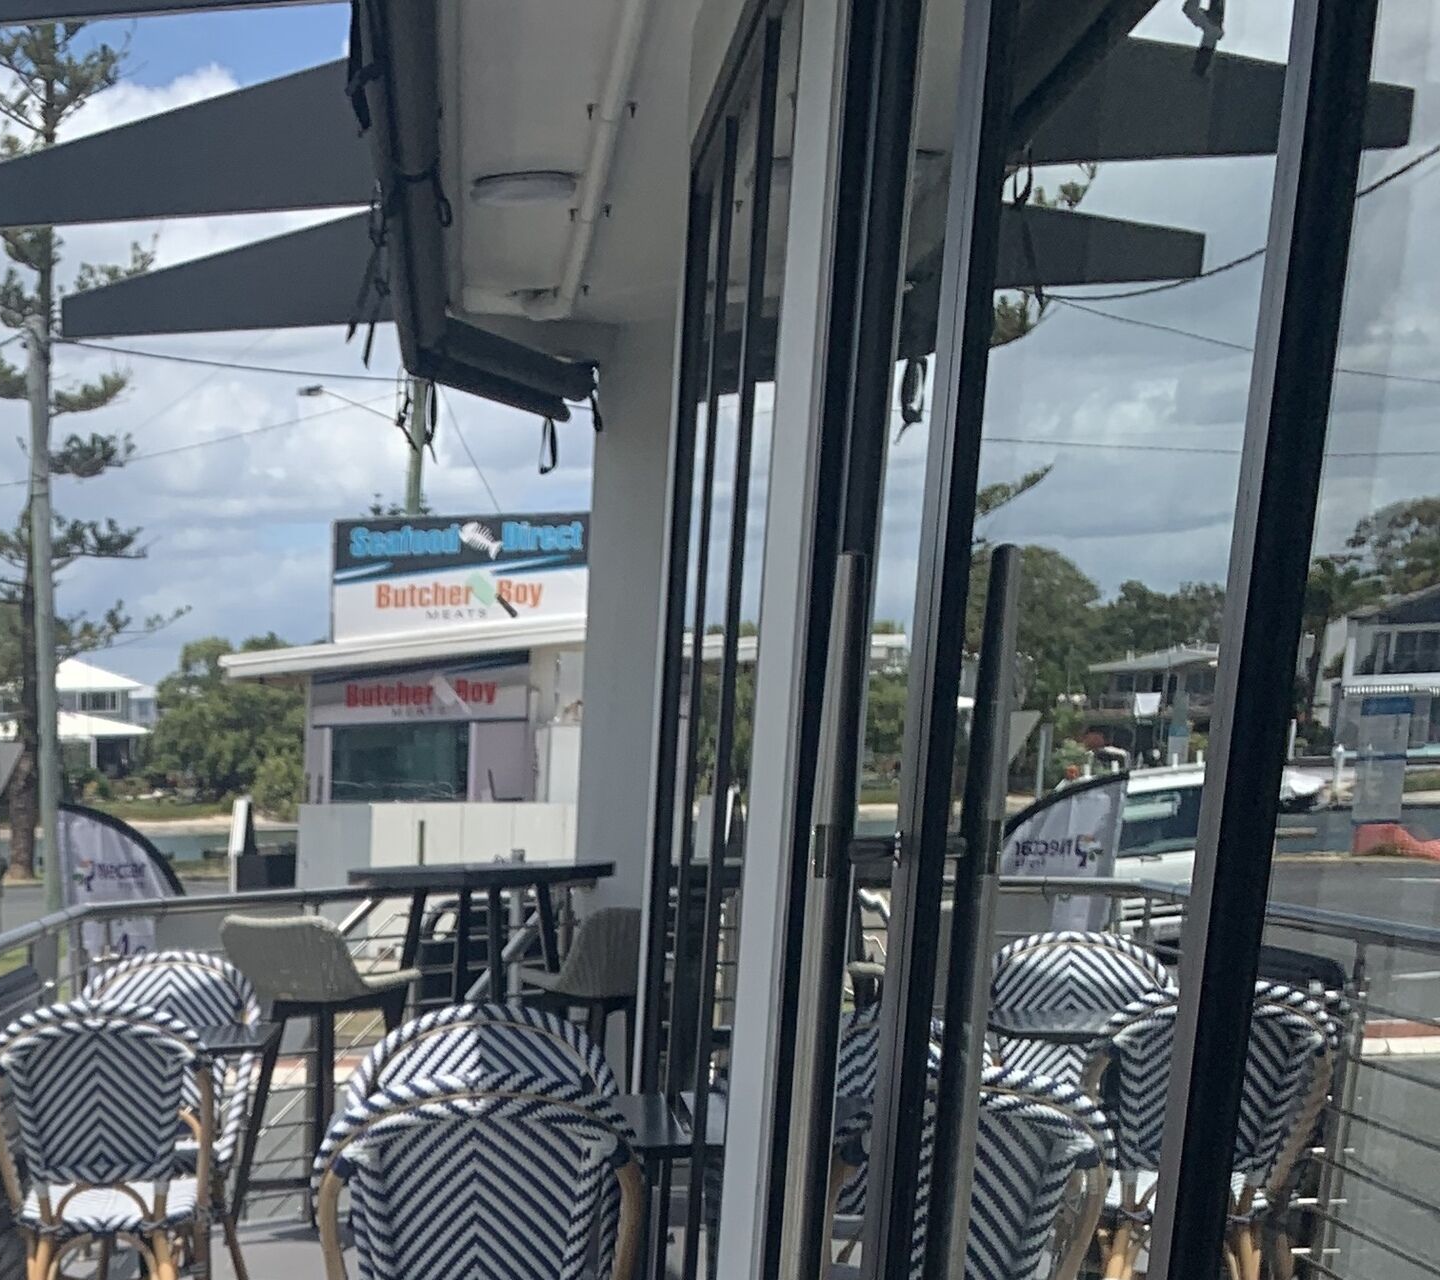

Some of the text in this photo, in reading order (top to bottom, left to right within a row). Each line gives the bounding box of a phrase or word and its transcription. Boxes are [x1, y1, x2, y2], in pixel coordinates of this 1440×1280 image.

[349, 520, 584, 557] Seafood Direct
[375, 579, 543, 609] Butcher Boy
[426, 608, 488, 620] MEATS
[346, 679, 498, 708] Butcher Boy
